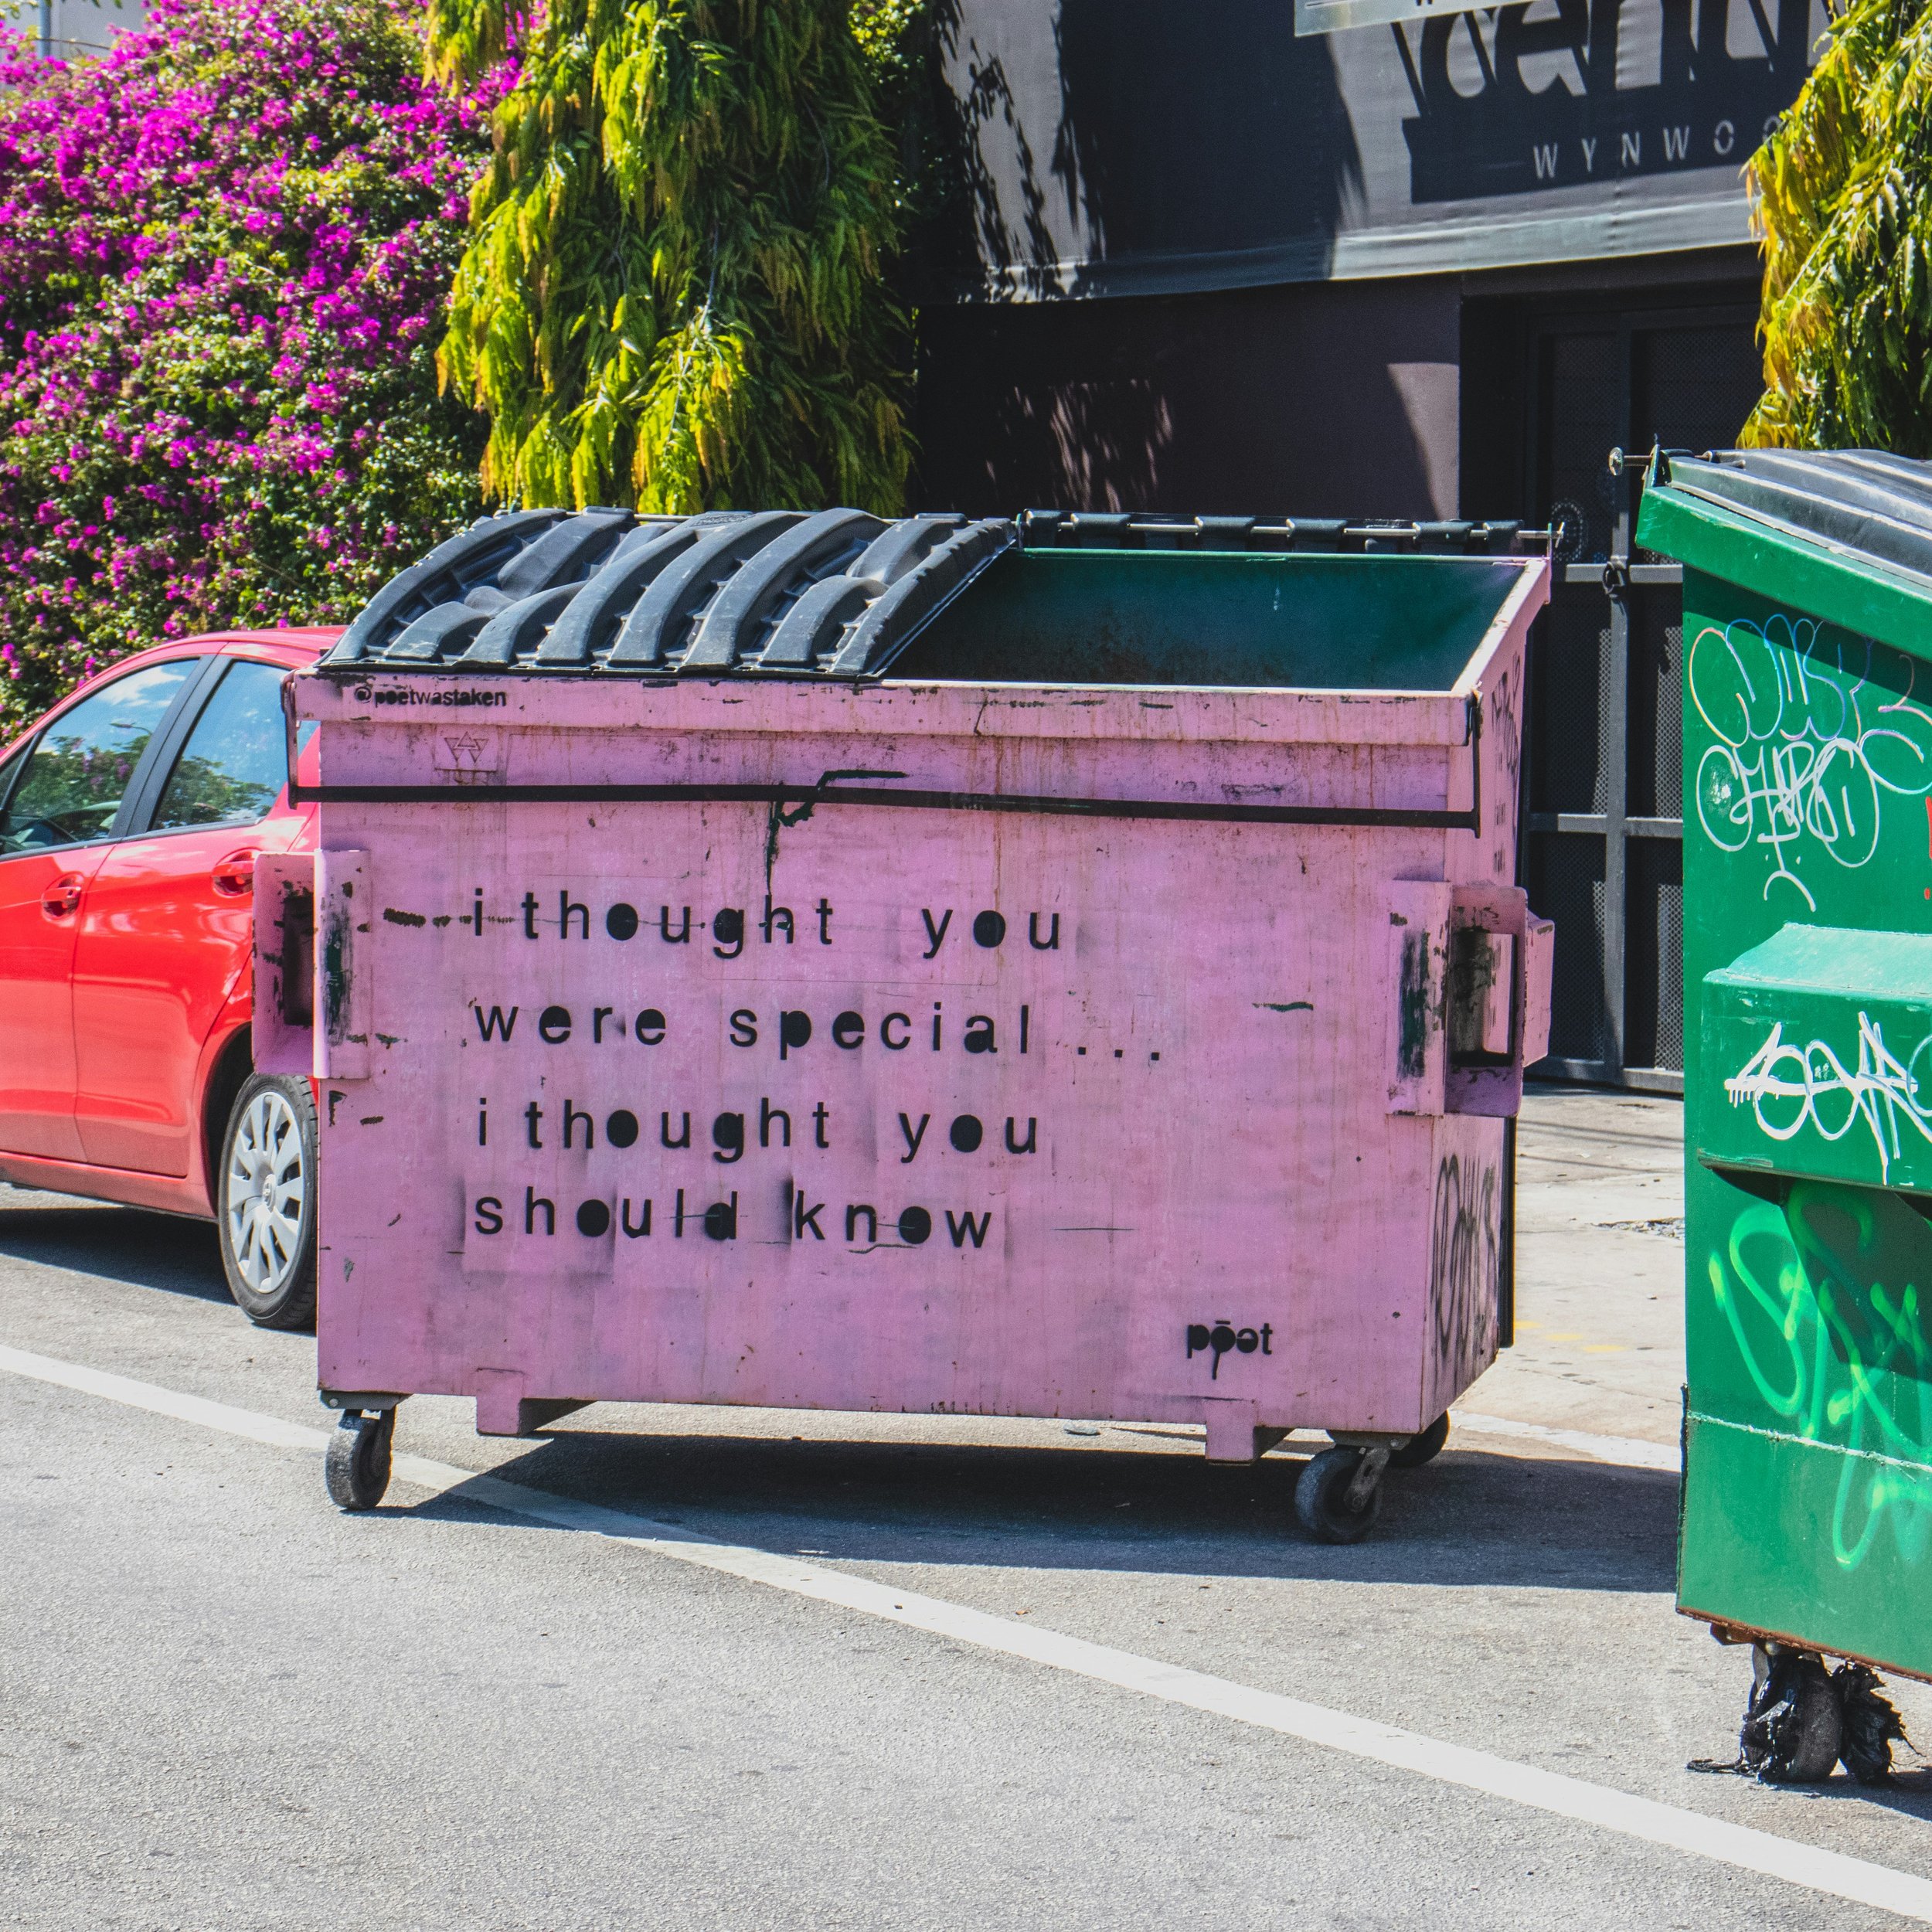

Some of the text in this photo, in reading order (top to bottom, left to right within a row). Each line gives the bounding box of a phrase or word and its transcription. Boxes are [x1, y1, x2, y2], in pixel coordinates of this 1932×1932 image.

[354, 686, 507, 708] @poetwastaken
[474, 887, 1060, 960] i thought you
[474, 1005, 666, 1046] were
[478, 1097, 1037, 1164] i thought you
[474, 1185, 992, 1249] should know
